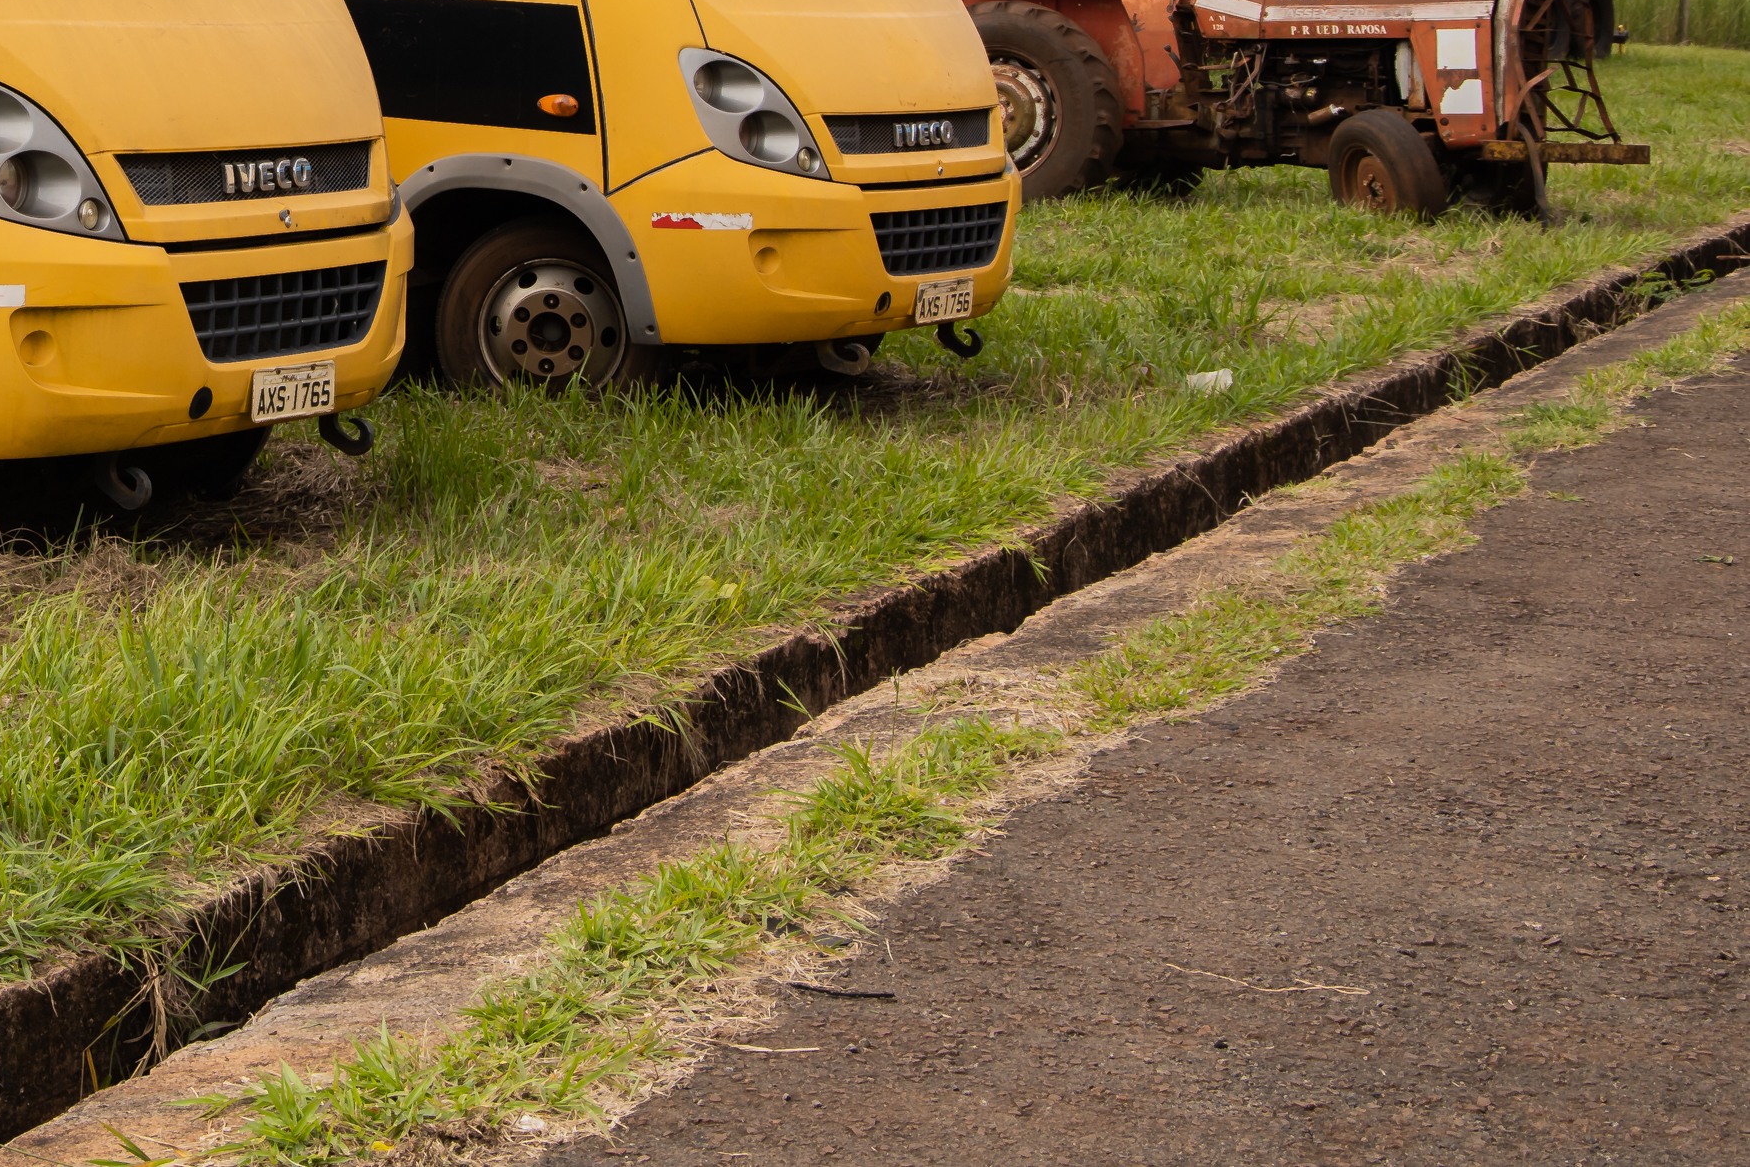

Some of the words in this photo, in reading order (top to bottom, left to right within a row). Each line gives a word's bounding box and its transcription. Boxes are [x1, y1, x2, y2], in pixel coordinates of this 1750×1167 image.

[1346, 24, 1387, 35] RAPOSA
[893, 120, 953, 148] IVECO
[221, 157, 312, 194] IVECO
